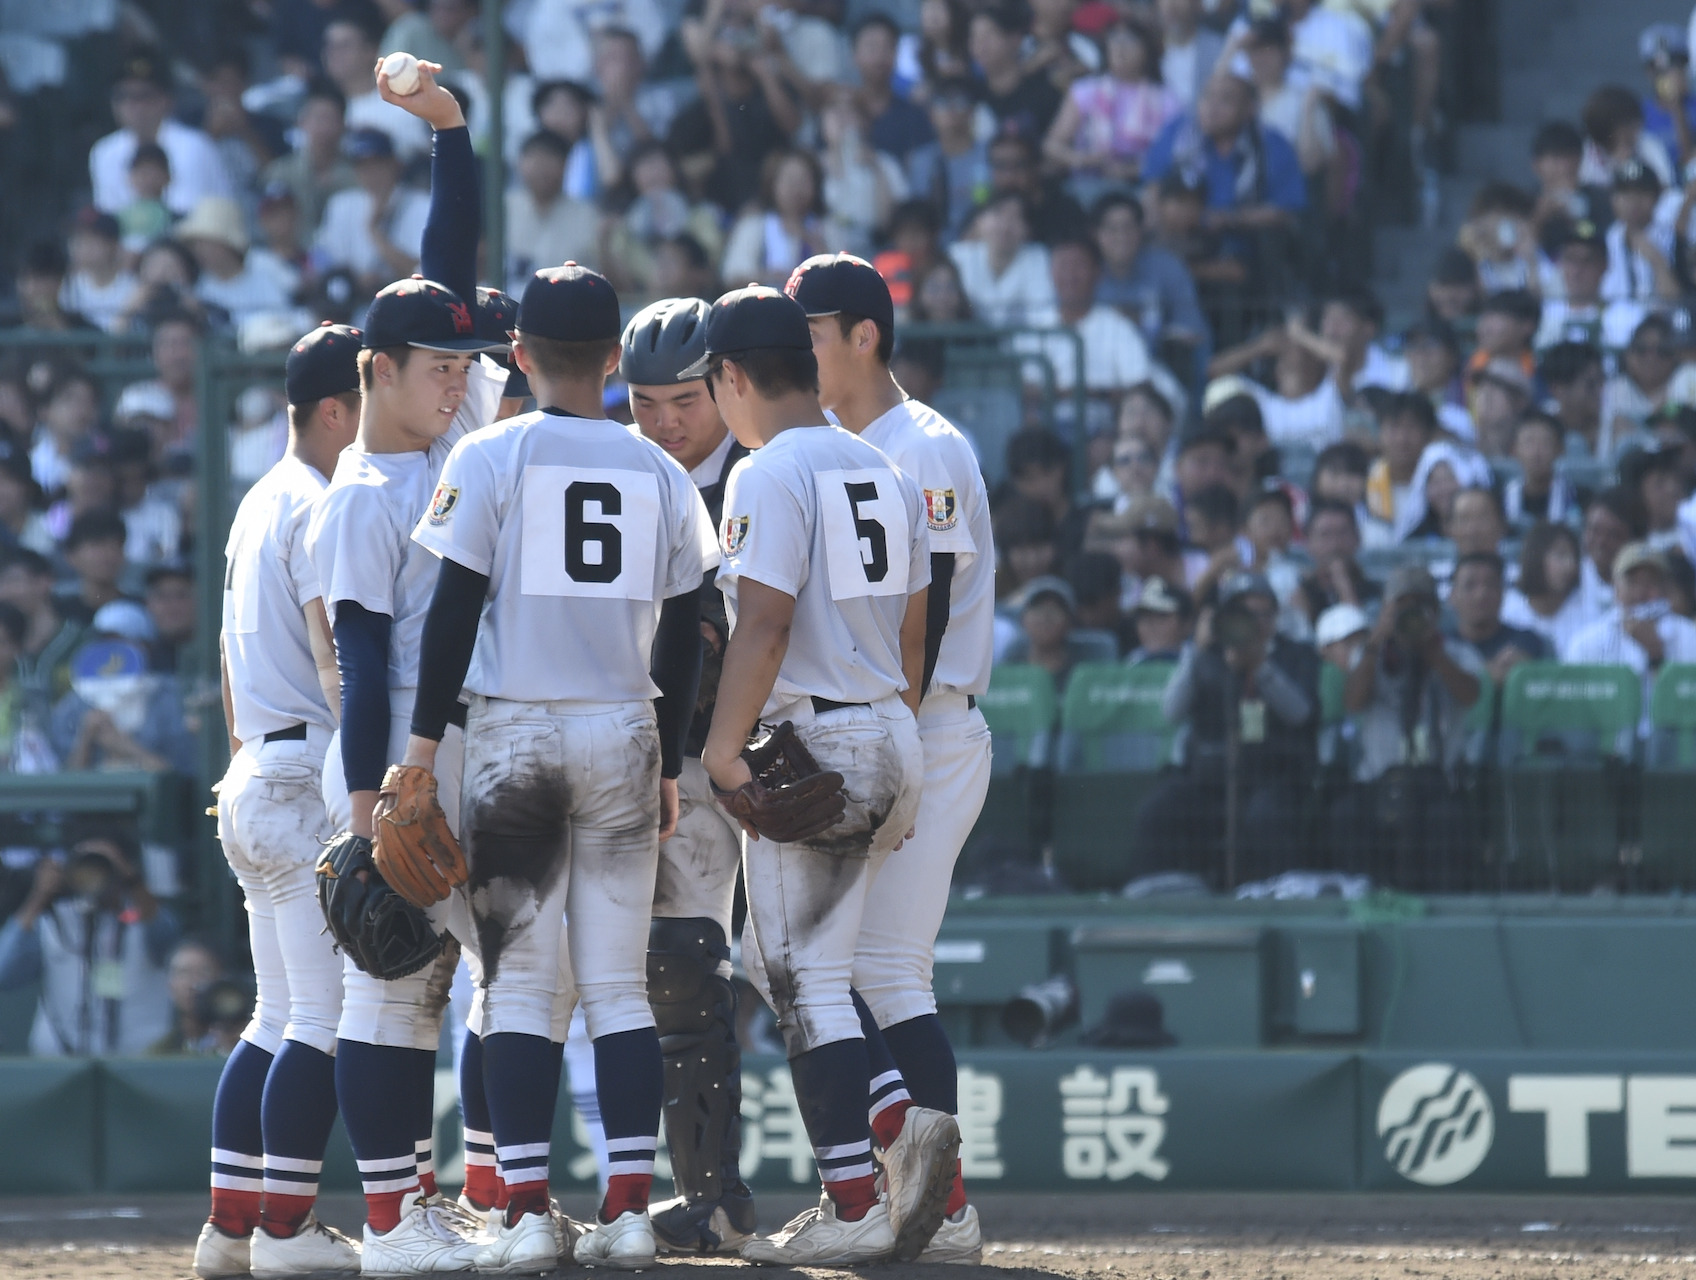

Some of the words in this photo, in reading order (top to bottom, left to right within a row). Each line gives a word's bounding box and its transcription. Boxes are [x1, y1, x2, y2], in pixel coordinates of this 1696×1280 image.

[565, 481, 622, 583] 6
[843, 481, 888, 583] 5
[1508, 1074, 1696, 1179] TE
